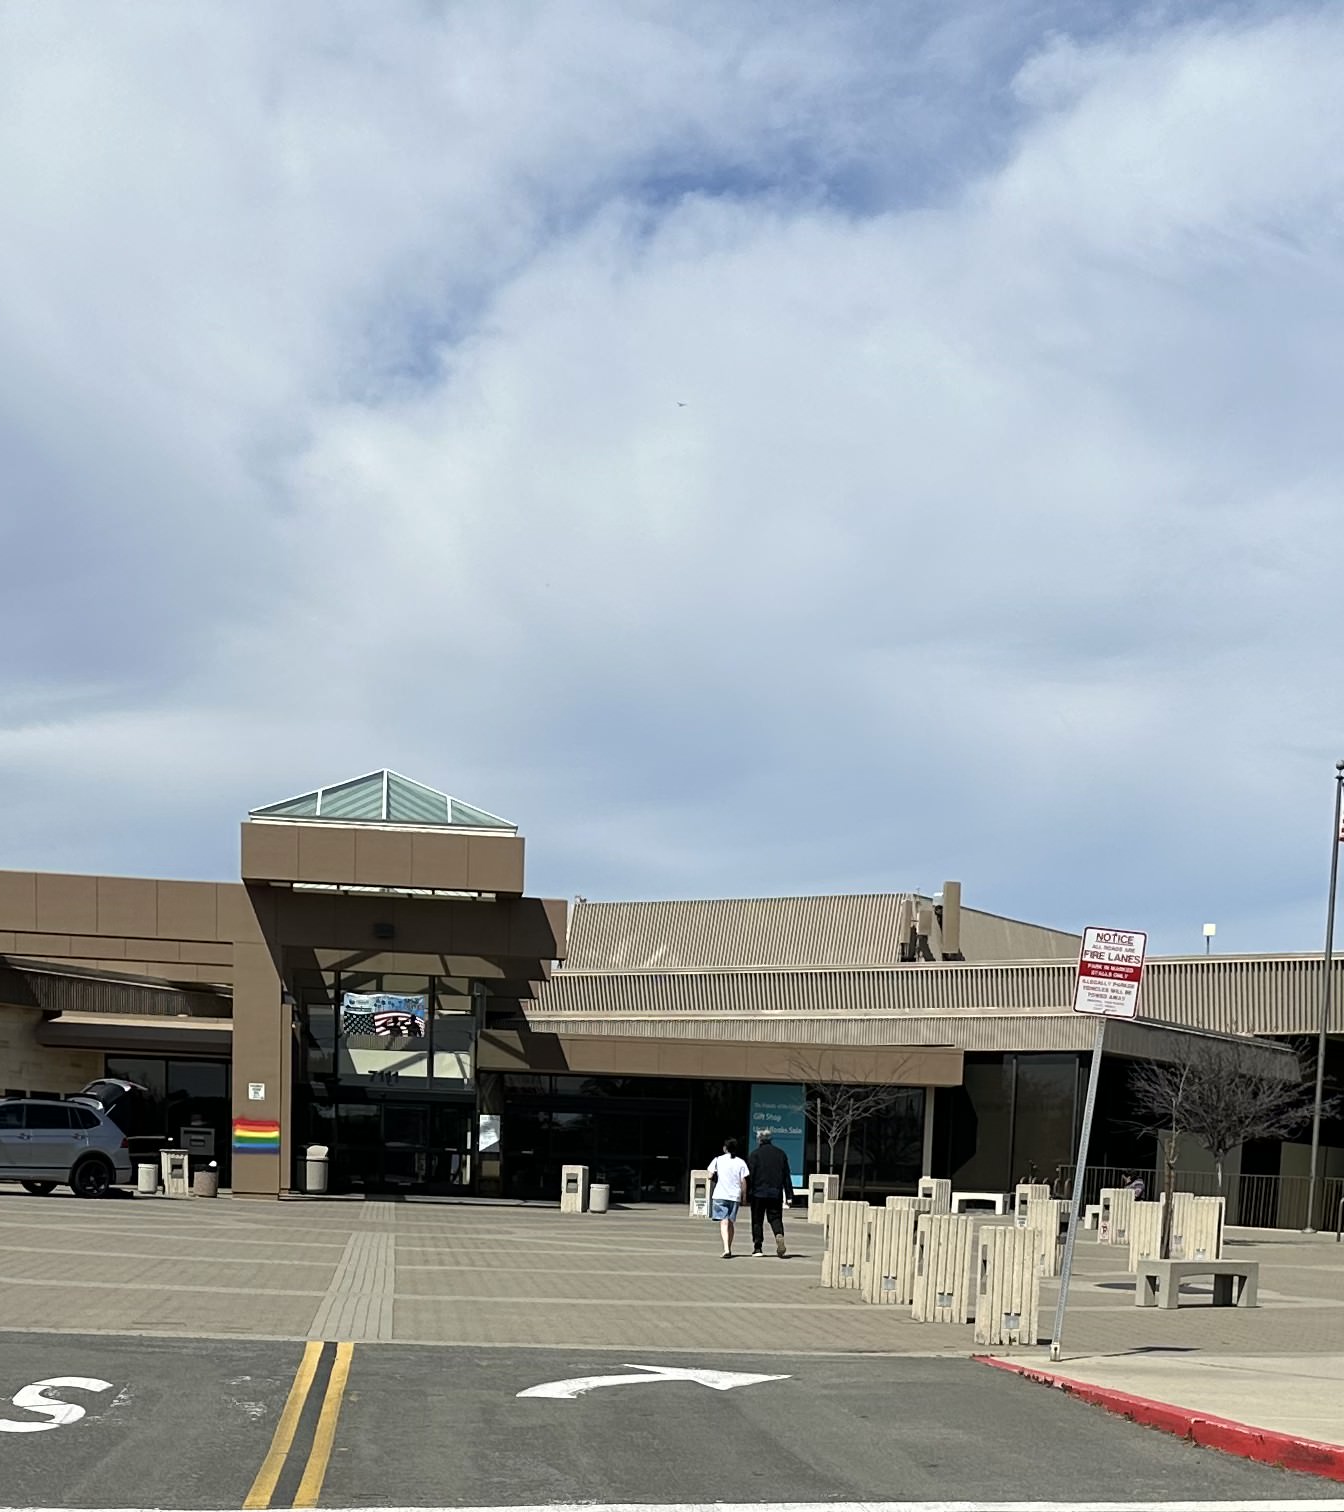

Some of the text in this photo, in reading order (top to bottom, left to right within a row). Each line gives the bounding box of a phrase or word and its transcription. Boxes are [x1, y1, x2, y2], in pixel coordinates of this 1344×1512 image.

[1096, 932, 1134, 945] NOTICE
[1083, 950, 1140, 964] FIRE LANES
